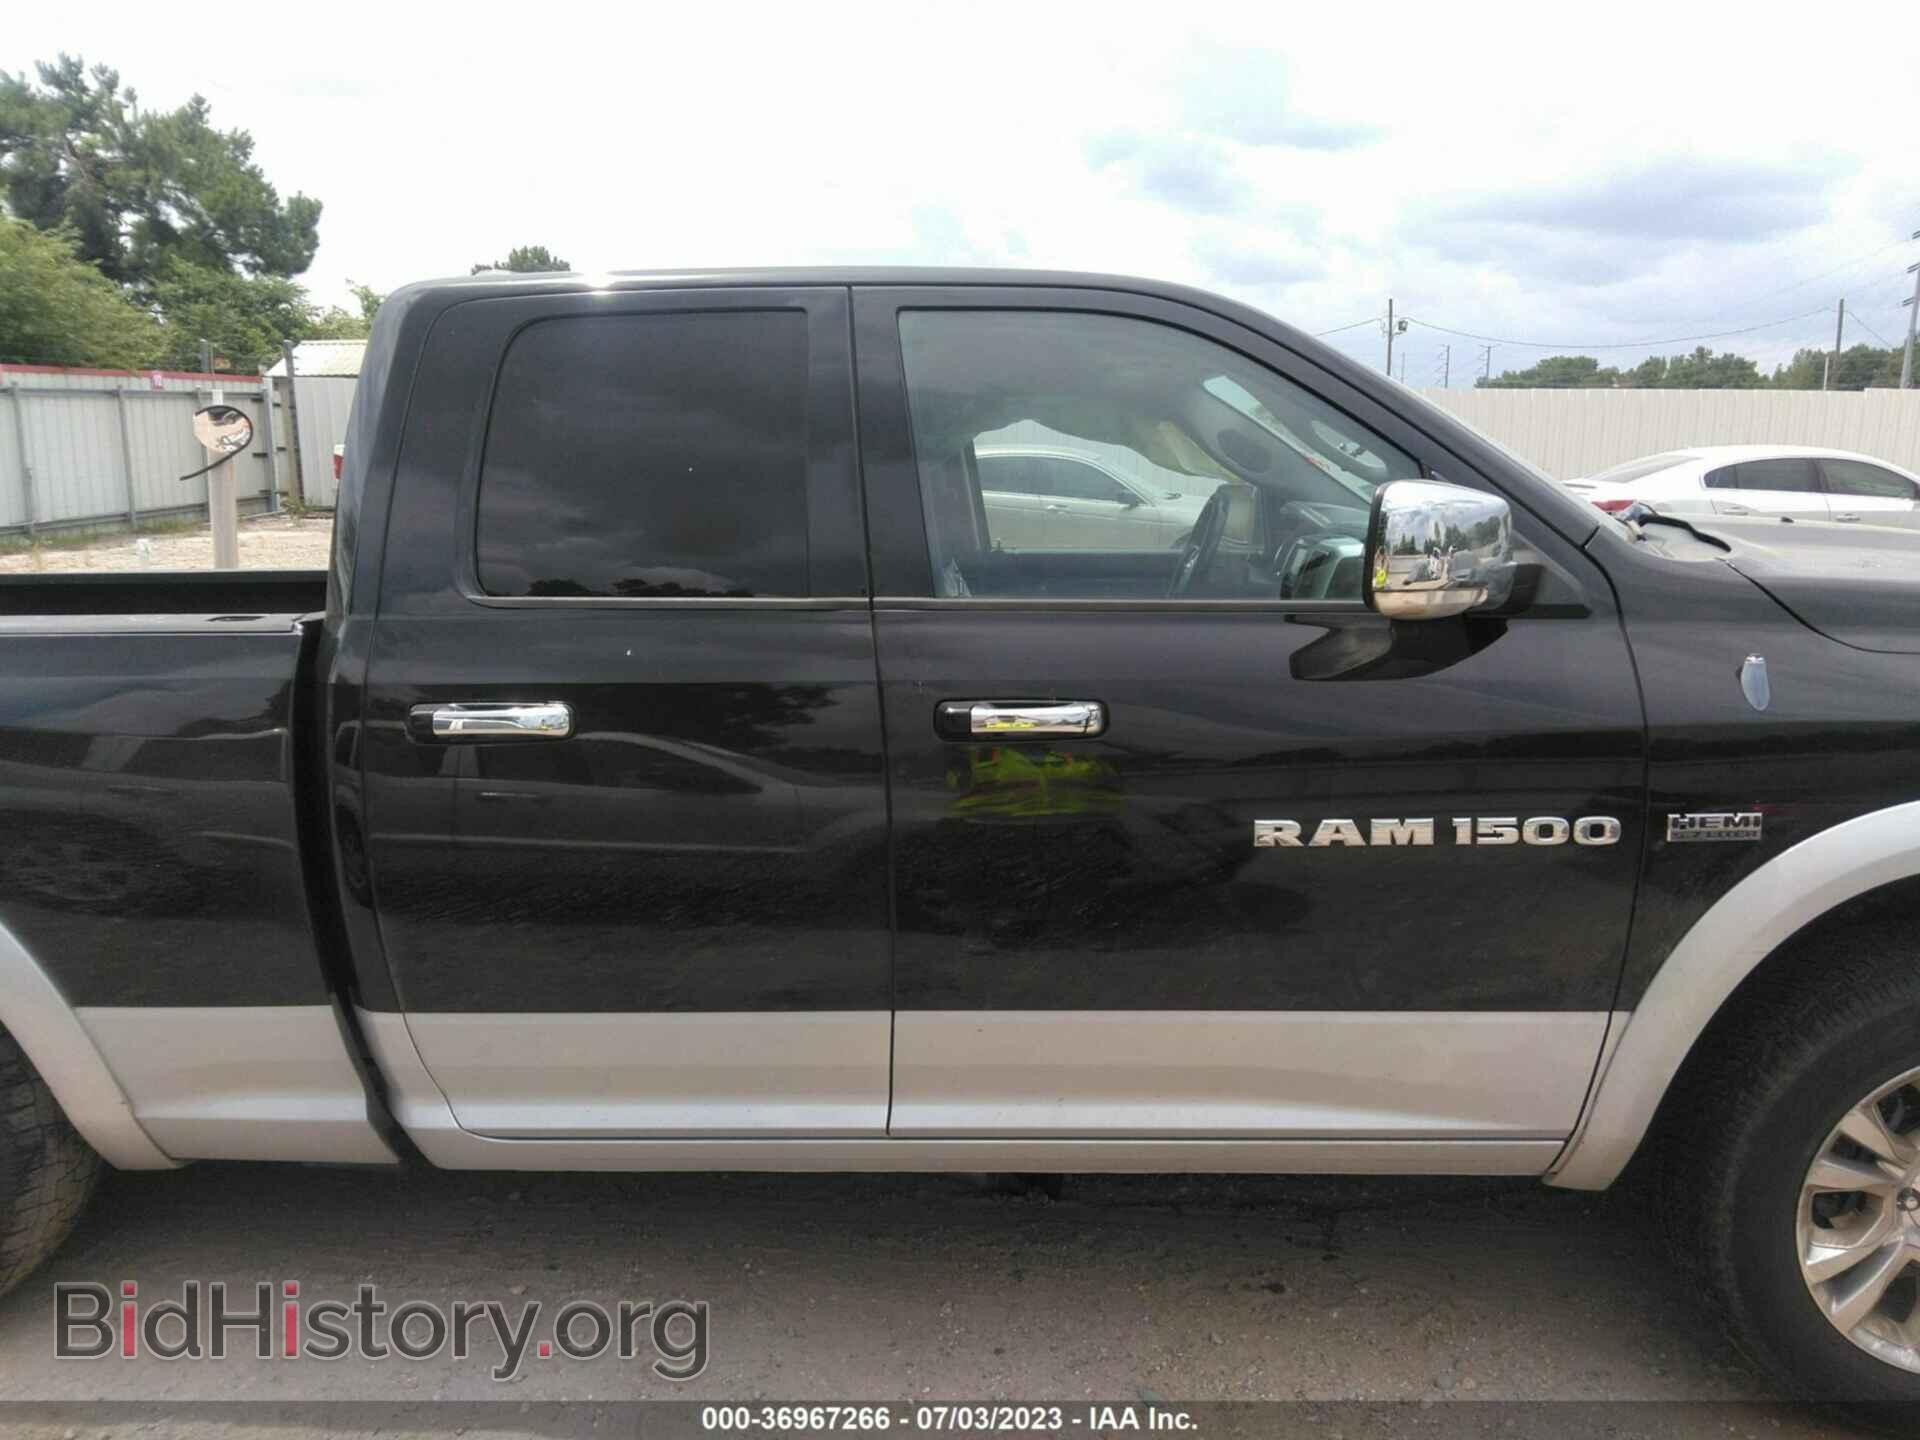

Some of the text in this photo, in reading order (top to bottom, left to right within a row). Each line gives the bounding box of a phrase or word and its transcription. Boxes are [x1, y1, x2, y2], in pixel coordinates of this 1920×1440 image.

[1253, 816, 1621, 847] RAM 1500
[1669, 813, 1762, 829] HEMI
